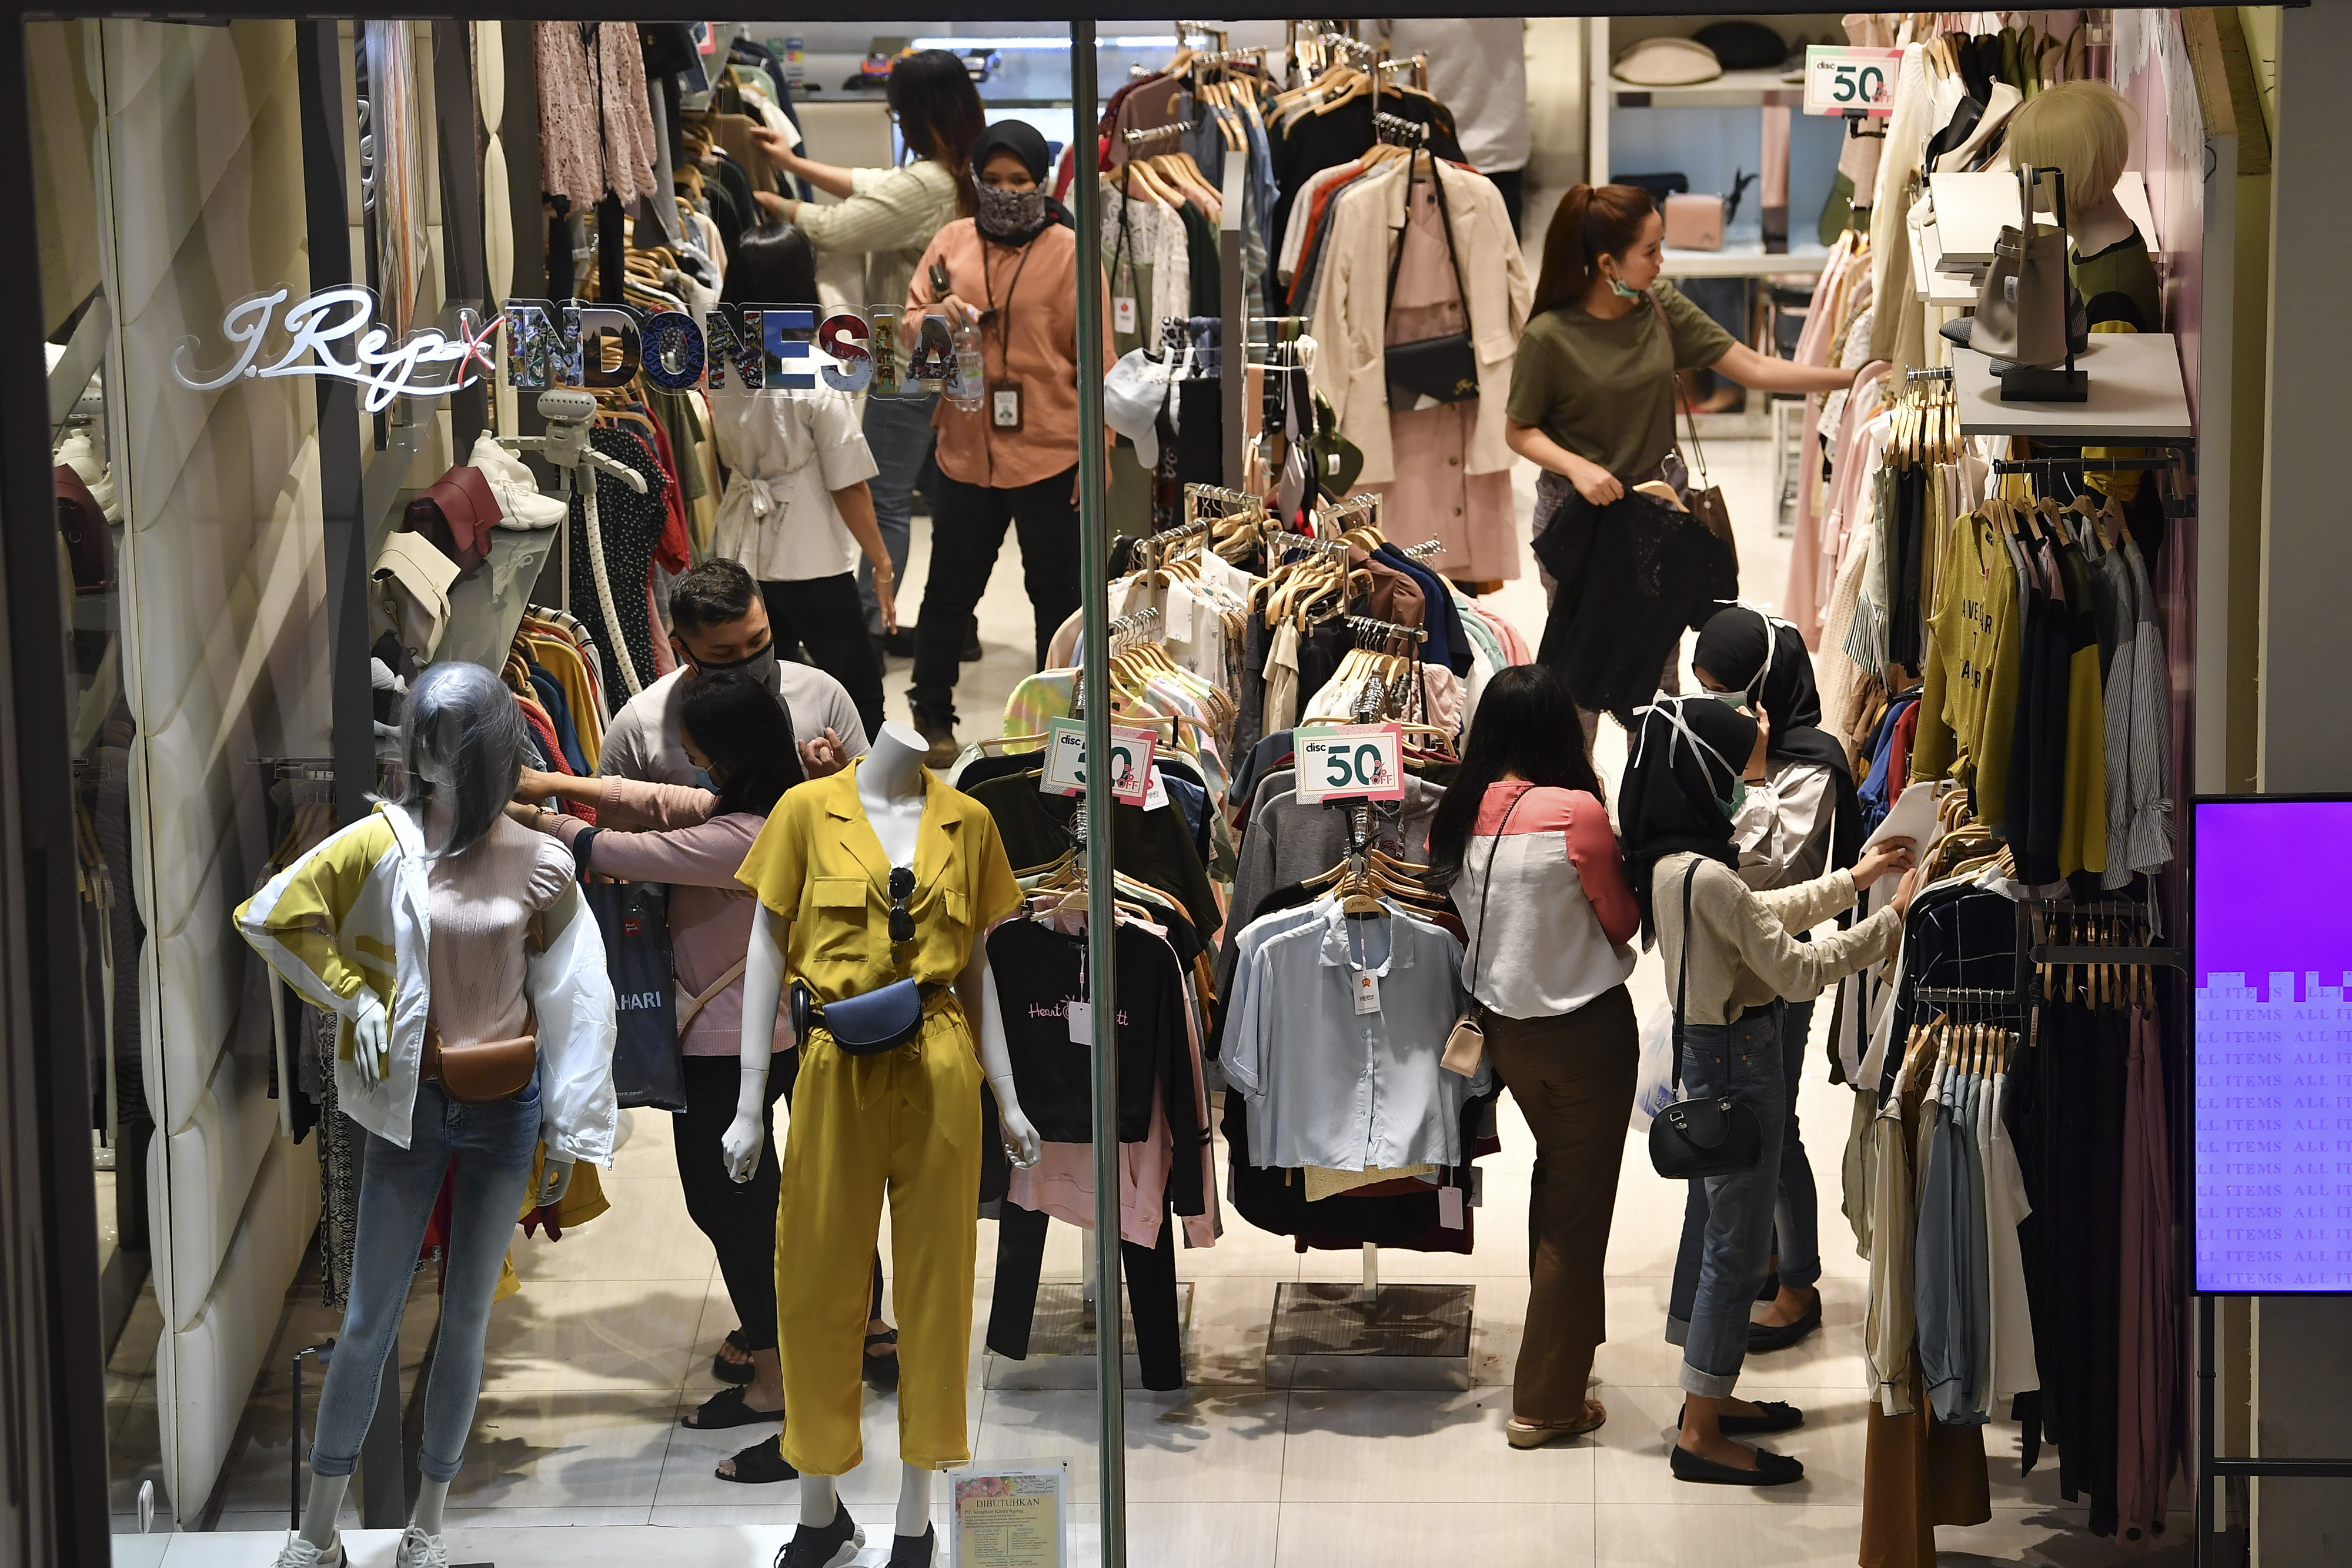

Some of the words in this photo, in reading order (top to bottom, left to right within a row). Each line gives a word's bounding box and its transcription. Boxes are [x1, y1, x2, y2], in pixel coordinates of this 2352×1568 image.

[1817, 61, 1835, 69] disc
[1833, 66, 1883, 102] 50
[503, 306, 968, 394] INDONESIA
[1061, 735, 1081, 746] disc
[1306, 743, 1327, 753] disc
[1326, 744, 1382, 787] 50
[1117, 778, 1140, 790] OFF
[1371, 774, 1393, 785] OFF
[2226, 987, 2282, 998] ITES
[1028, 1002, 1063, 1019] Heart
[2226, 1008, 2281, 1021] ITEMS
[2294, 1008, 2328, 1020] ALL
[2226, 1031, 2281, 1043] ITEMS
[2294, 1030, 2328, 1042] ALL
[2226, 1052, 2281, 1065] ITEMS
[2294, 1052, 2328, 1064] ALL
[2226, 1075, 2281, 1086] ITEMS
[2294, 1074, 2328, 1086] ALL
[2226, 1097, 2281, 1109] ITEMS
[2294, 1096, 2328, 1108] ALL
[2226, 1119, 2281, 1131] ITEMS
[2294, 1118, 2328, 1130] ALL
[2226, 1141, 2281, 1152] ITEMS
[2294, 1140, 2328, 1152] ALL
[2226, 1163, 2281, 1175] ITEMS
[2294, 1162, 2328, 1174] ALL
[2226, 1185, 2281, 1196] ITEMS
[2294, 1184, 2328, 1196] ALL
[2226, 1206, 2281, 1218] ITEMS
[2294, 1206, 2328, 1218] ALL
[2226, 1229, 2281, 1240] ITEMS
[2294, 1228, 2328, 1239] ALL
[2226, 1251, 2281, 1262] ITEMS
[2294, 1250, 2328, 1261] ALL
[2226, 1272, 2281, 1283] ITEMS
[2294, 1272, 2328, 1283] ALL
[976, 1498, 1040, 1508] DIBUTUHKAN
